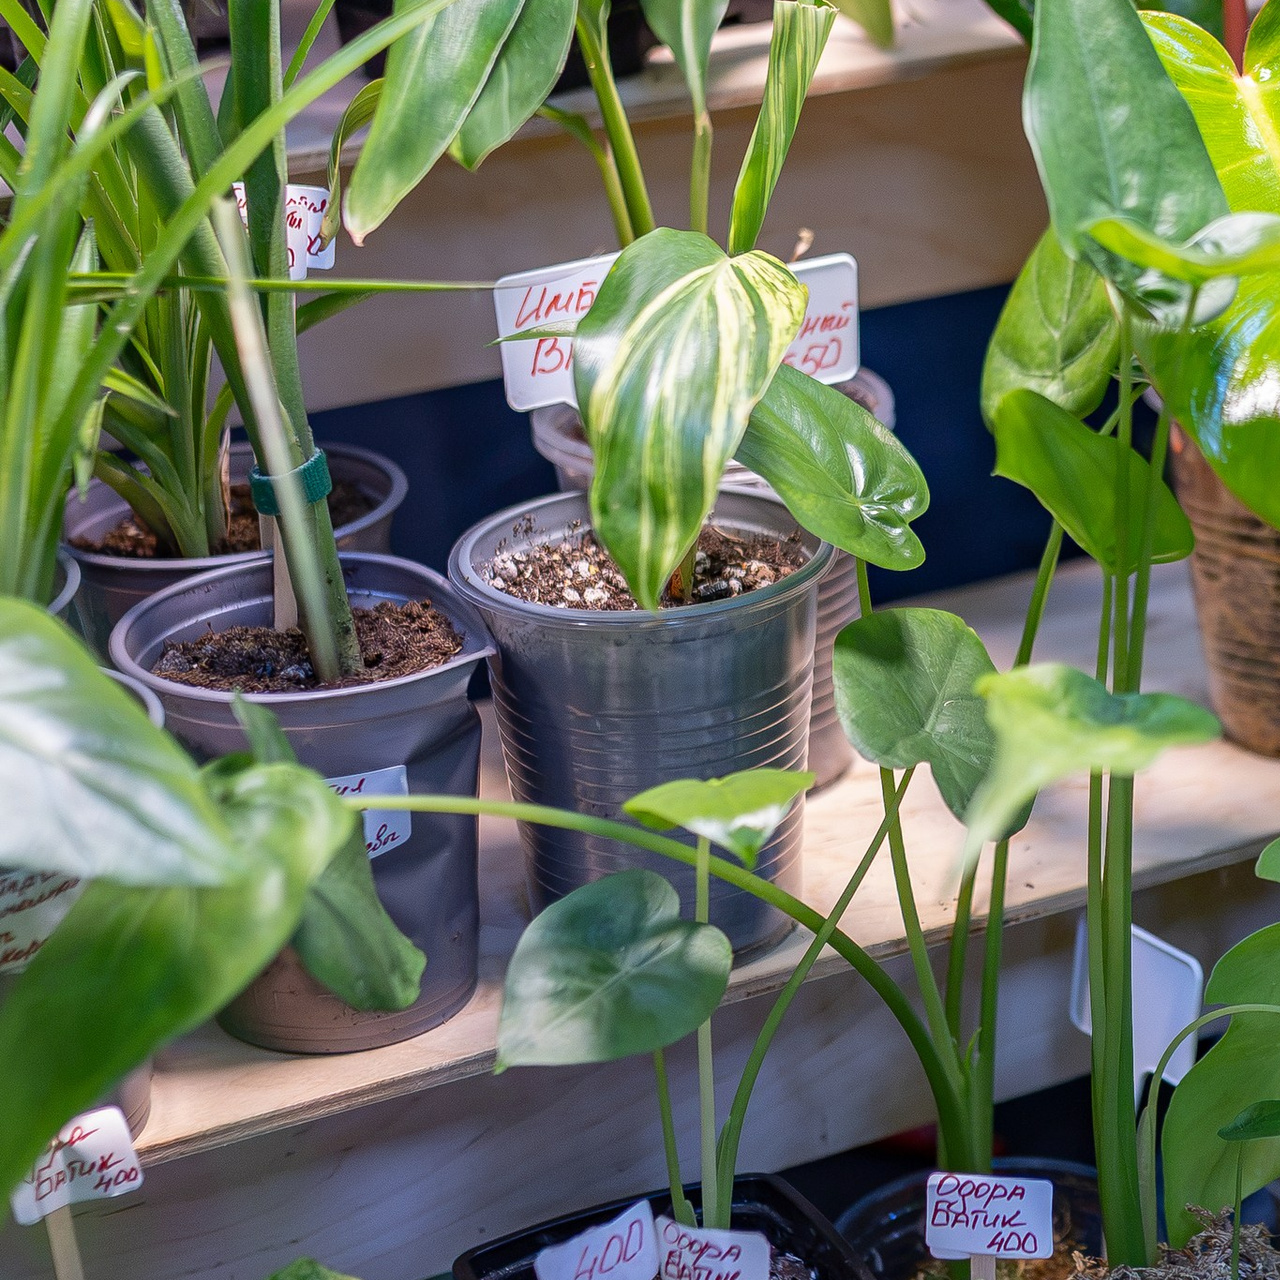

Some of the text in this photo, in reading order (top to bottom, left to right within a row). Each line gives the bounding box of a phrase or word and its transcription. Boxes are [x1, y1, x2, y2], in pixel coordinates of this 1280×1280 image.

[514, 281, 598, 329] Имб
[93, 1166, 139, 1194] 400
[986, 1231, 1038, 1254] 400
